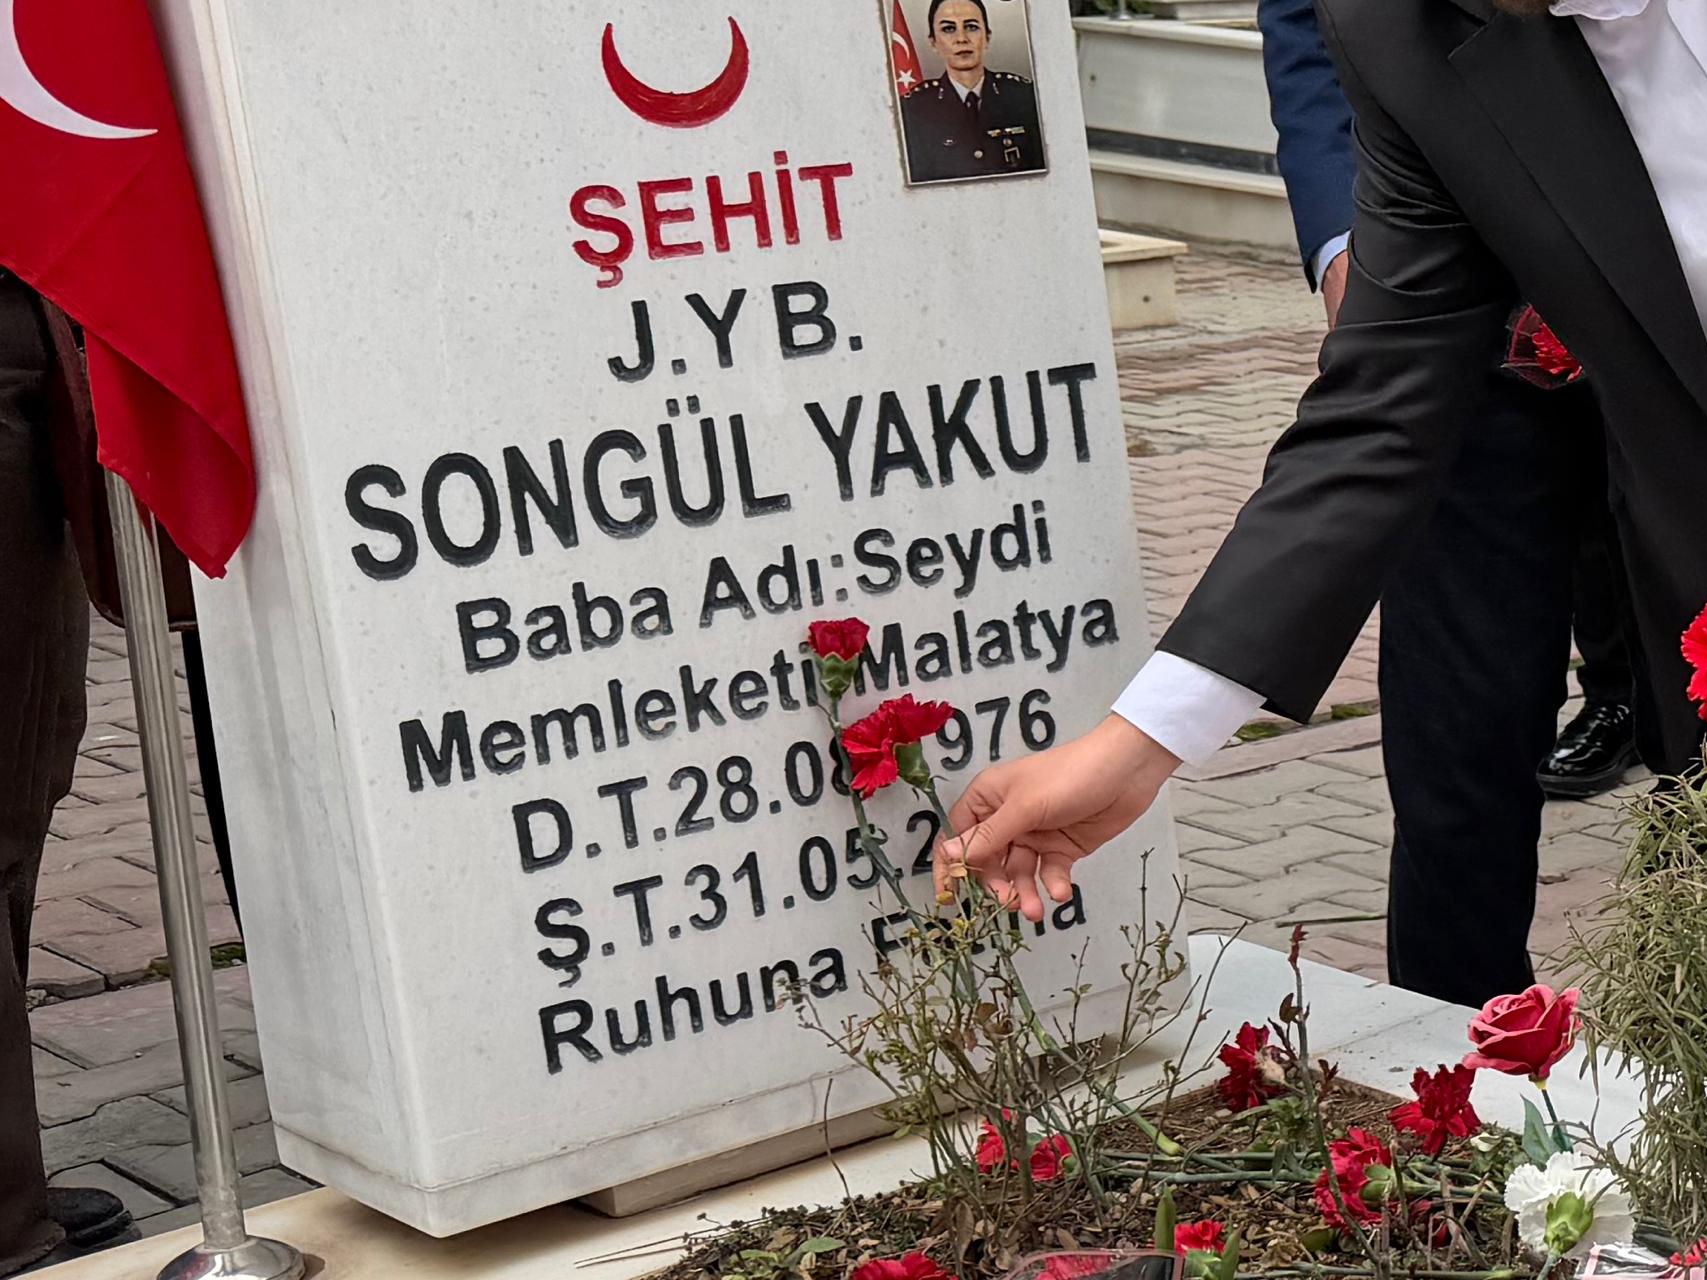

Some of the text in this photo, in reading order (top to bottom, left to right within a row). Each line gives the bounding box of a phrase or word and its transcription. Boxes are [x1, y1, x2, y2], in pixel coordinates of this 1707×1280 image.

[568, 149, 854, 289] ŞEHİT
[344, 361, 1102, 581] SONGÜL YAKUT
[456, 578, 675, 674] Baba
[537, 942, 848, 1074] Ruhuna
